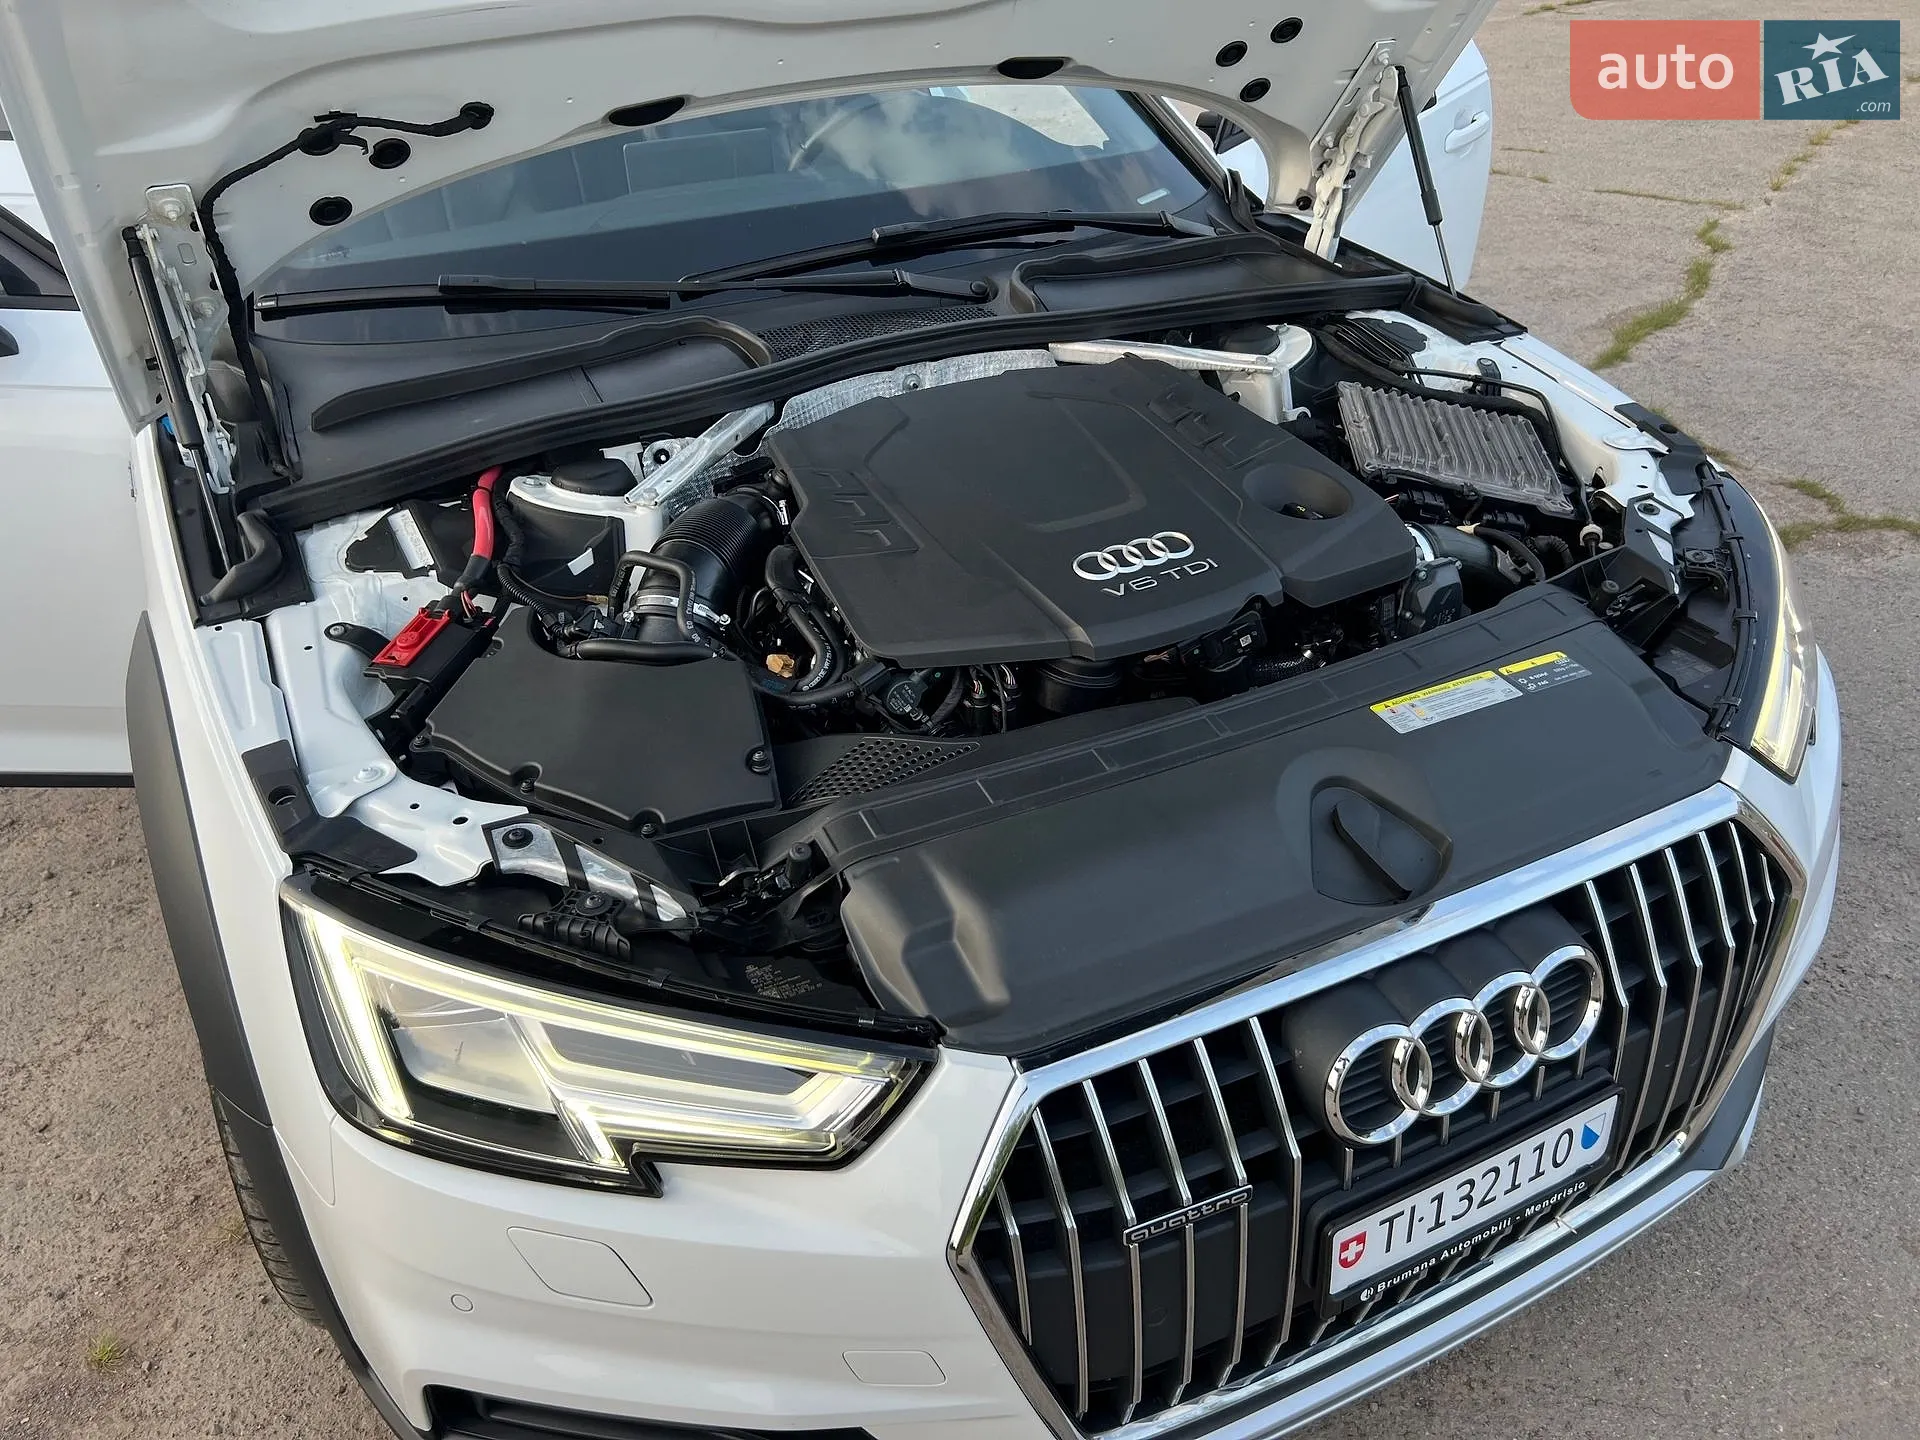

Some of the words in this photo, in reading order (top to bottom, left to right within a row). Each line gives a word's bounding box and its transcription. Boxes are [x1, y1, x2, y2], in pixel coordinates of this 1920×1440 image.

[1100, 576, 1158, 597] V6
[1159, 558, 1219, 580] TDI
[1130, 1192, 1248, 1244] quattro
[1376, 1256, 1437, 1294] Brumana
[1440, 1217, 1512, 1259] Automobili
[1525, 1180, 1586, 1219] Mendrisio
